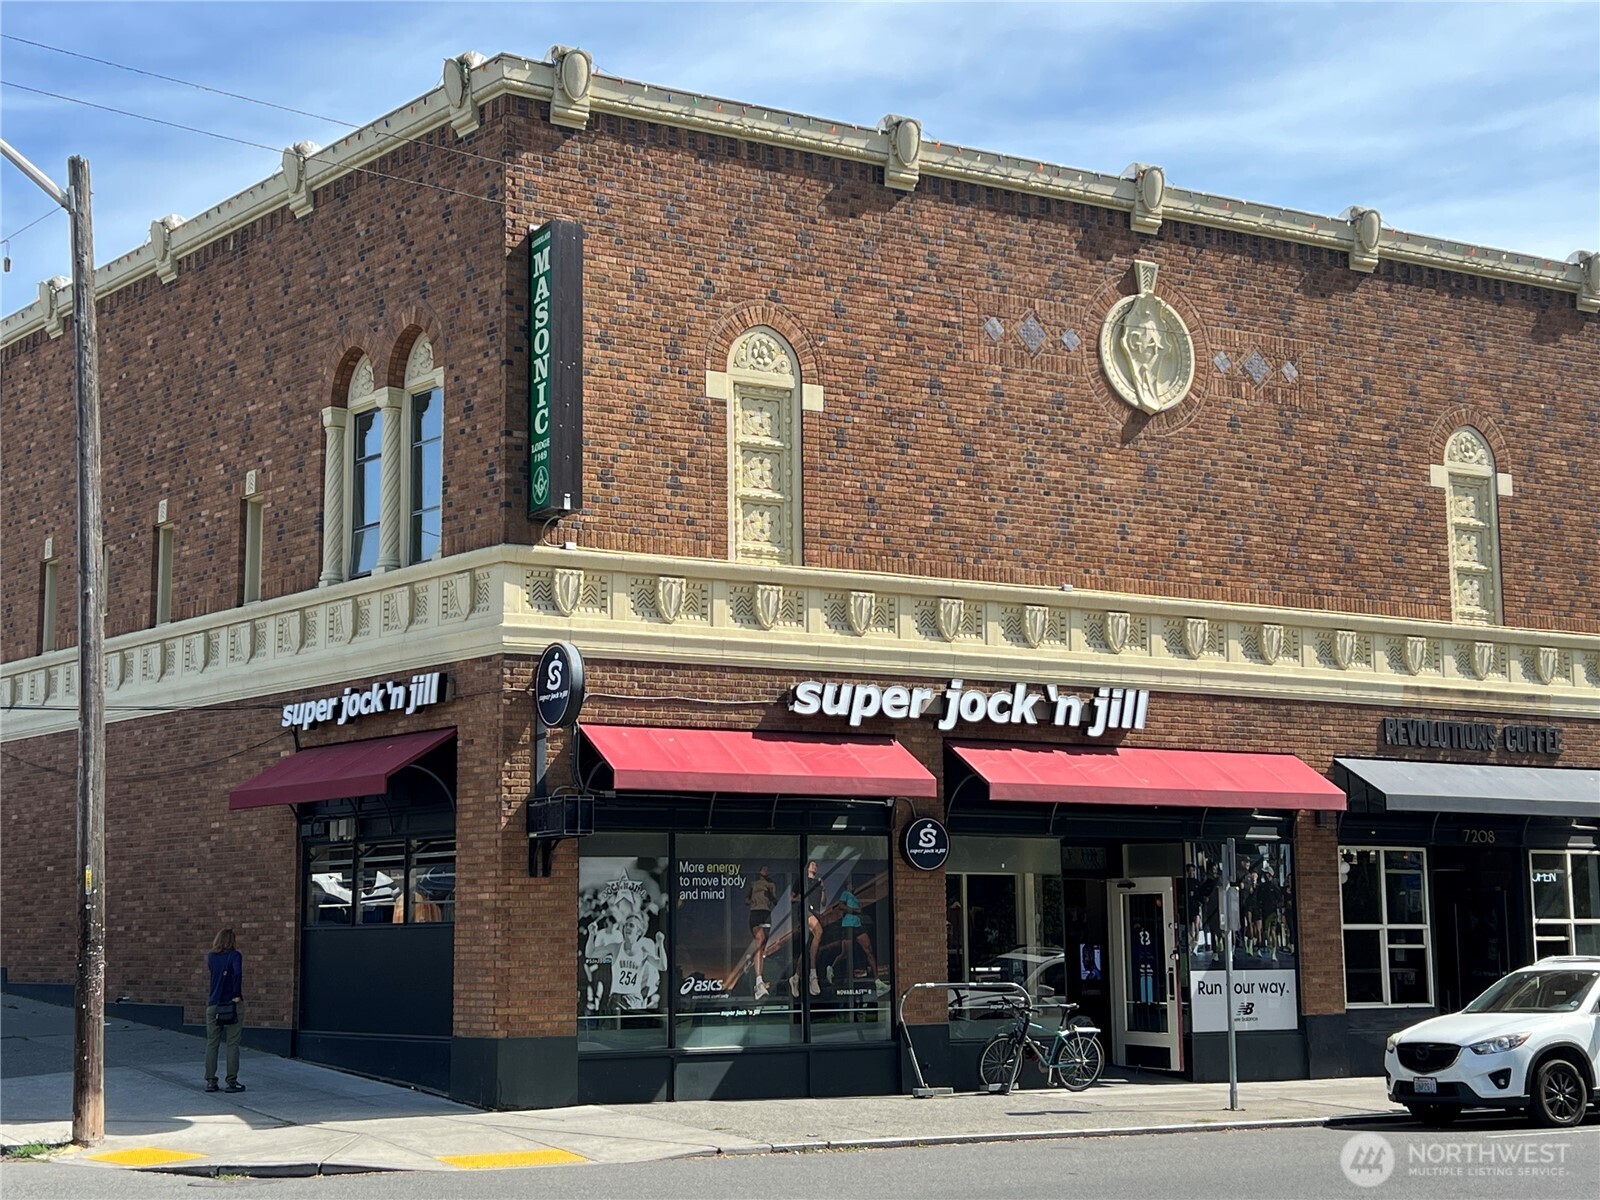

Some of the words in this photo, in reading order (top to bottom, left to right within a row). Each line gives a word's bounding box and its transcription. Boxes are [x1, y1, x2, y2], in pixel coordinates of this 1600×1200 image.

[533, 246, 551, 435] MASONIC
[531, 437, 551, 454] LODGE
[281, 697, 339, 731] super
[337, 687, 386, 725] jock
[405, 672, 440, 715] jill
[792, 680, 933, 726] super
[937, 679, 1041, 731] jock
[1087, 687, 1149, 737] jill
[1384, 718, 1497, 751] REVOLUTIONS
[1463, 829, 1496, 844] 7208
[679, 860, 705, 873] More
[706, 863, 741, 876] energy
[679, 875, 690, 887] to
[691, 877, 719, 887] move
[720, 874, 747, 889] body
[679, 887, 699, 900] and
[700, 887, 725, 900] mind
[618, 970, 638, 986] 254
[1198, 980, 1222, 995] Run
[1226, 982, 1255, 994] our
[1258, 981, 1290, 996] way.
